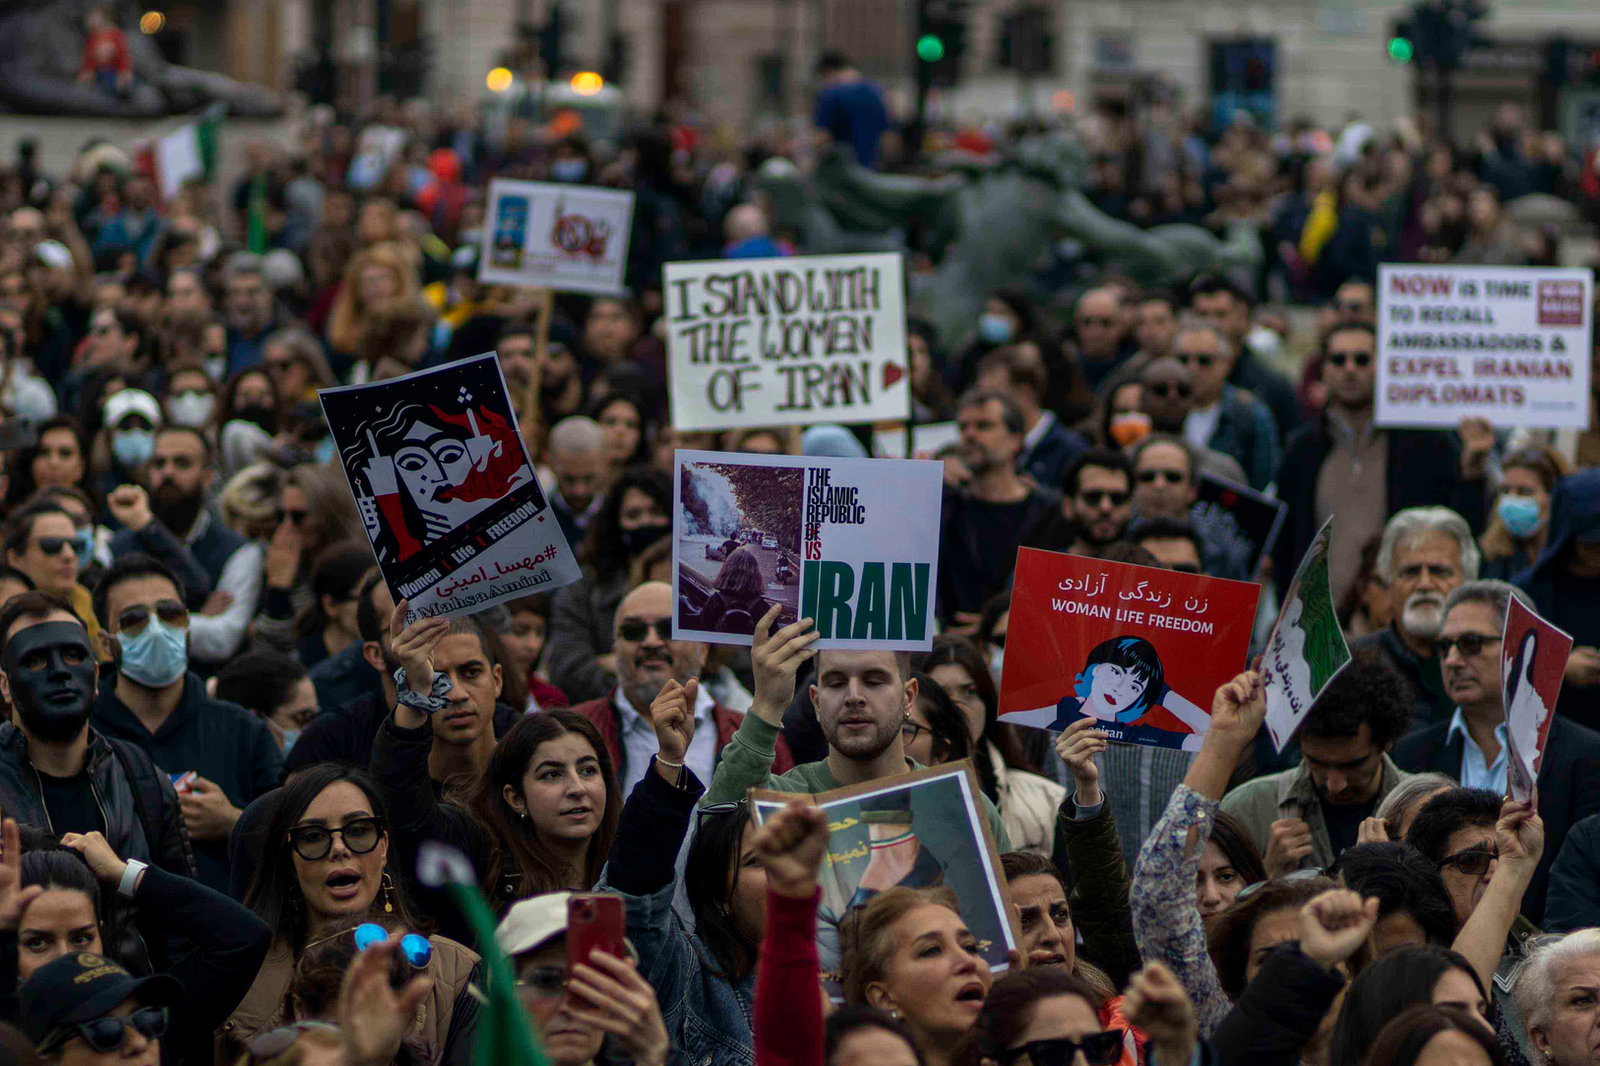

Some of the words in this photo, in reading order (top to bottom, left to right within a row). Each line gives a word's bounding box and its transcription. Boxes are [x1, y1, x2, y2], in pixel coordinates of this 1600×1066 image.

[670, 278, 699, 322] I
[703, 270, 802, 318] STAND
[804, 266, 881, 313] WITH
[1390, 273, 1452, 298] NOW
[1485, 280, 1532, 297] TIME
[1388, 305, 1414, 323] TO
[1418, 305, 1495, 324] RECALL
[678, 320, 753, 365] THE
[760, 314, 873, 361] WOMEN
[1389, 332, 1544, 351] AMBASSADORS
[1387, 356, 1460, 378] EXPEL
[1473, 357, 1573, 379] IRANIAN
[706, 365, 762, 413] OF
[775, 361, 871, 412] IRAN
[1387, 382, 1526, 405] DIPLOMATS
[808, 467, 831, 487] THE
[807, 485, 858, 506] ISLAMIC
[806, 504, 865, 525] REPUBLIC
[397, 568, 443, 599] Women
[450, 543, 477, 565] Life
[485, 501, 539, 541] FREEDOM
[805, 541, 821, 560] VS
[1058, 572, 1109, 597] آزادی
[1118, 581, 1172, 608] زندگی
[802, 560, 930, 641] IRAN
[1184, 596, 1209, 614] زن
[1051, 598, 1111, 619] WOMAN
[1115, 608, 1145, 624] LIFE
[1148, 614, 1214, 635] FREEDOM
